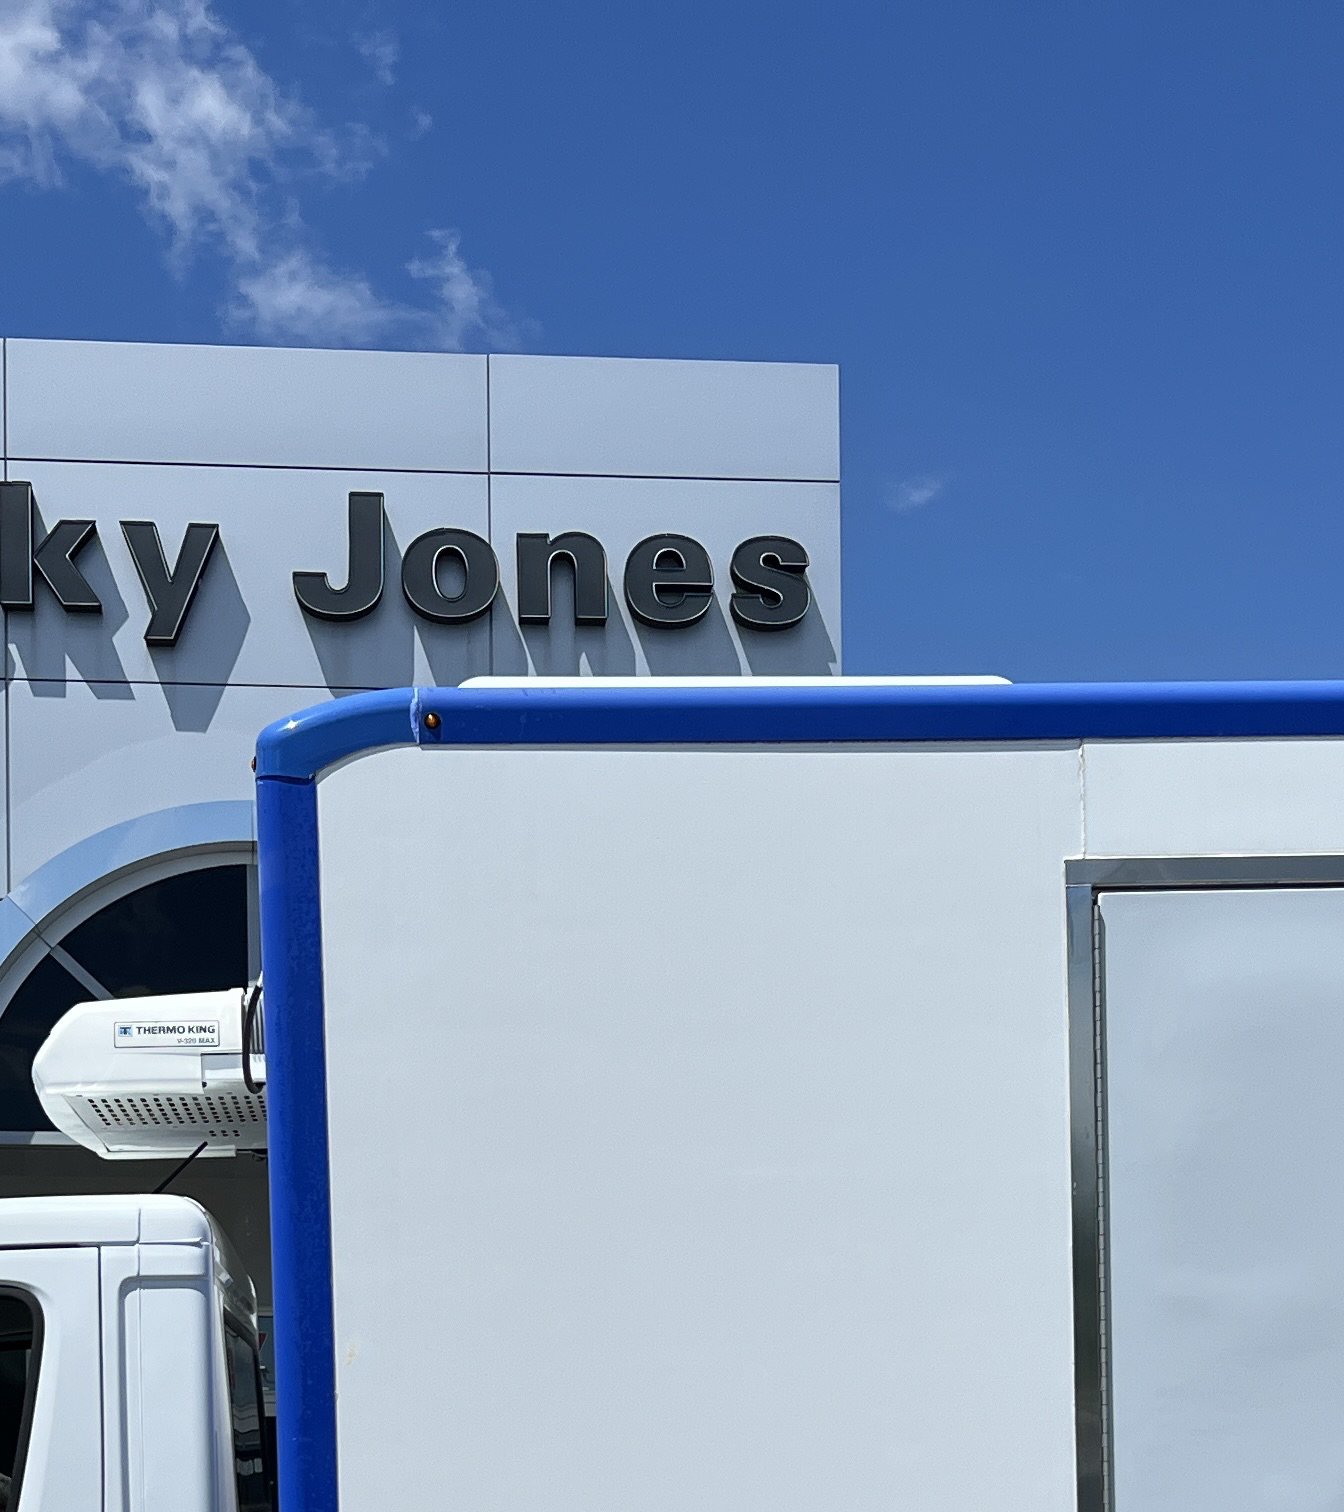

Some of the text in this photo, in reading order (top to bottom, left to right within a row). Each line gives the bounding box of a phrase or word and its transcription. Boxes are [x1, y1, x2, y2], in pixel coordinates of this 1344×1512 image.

[292, 491, 810, 631] Jones
[136, 1025, 216, 1035] THERMO KING
